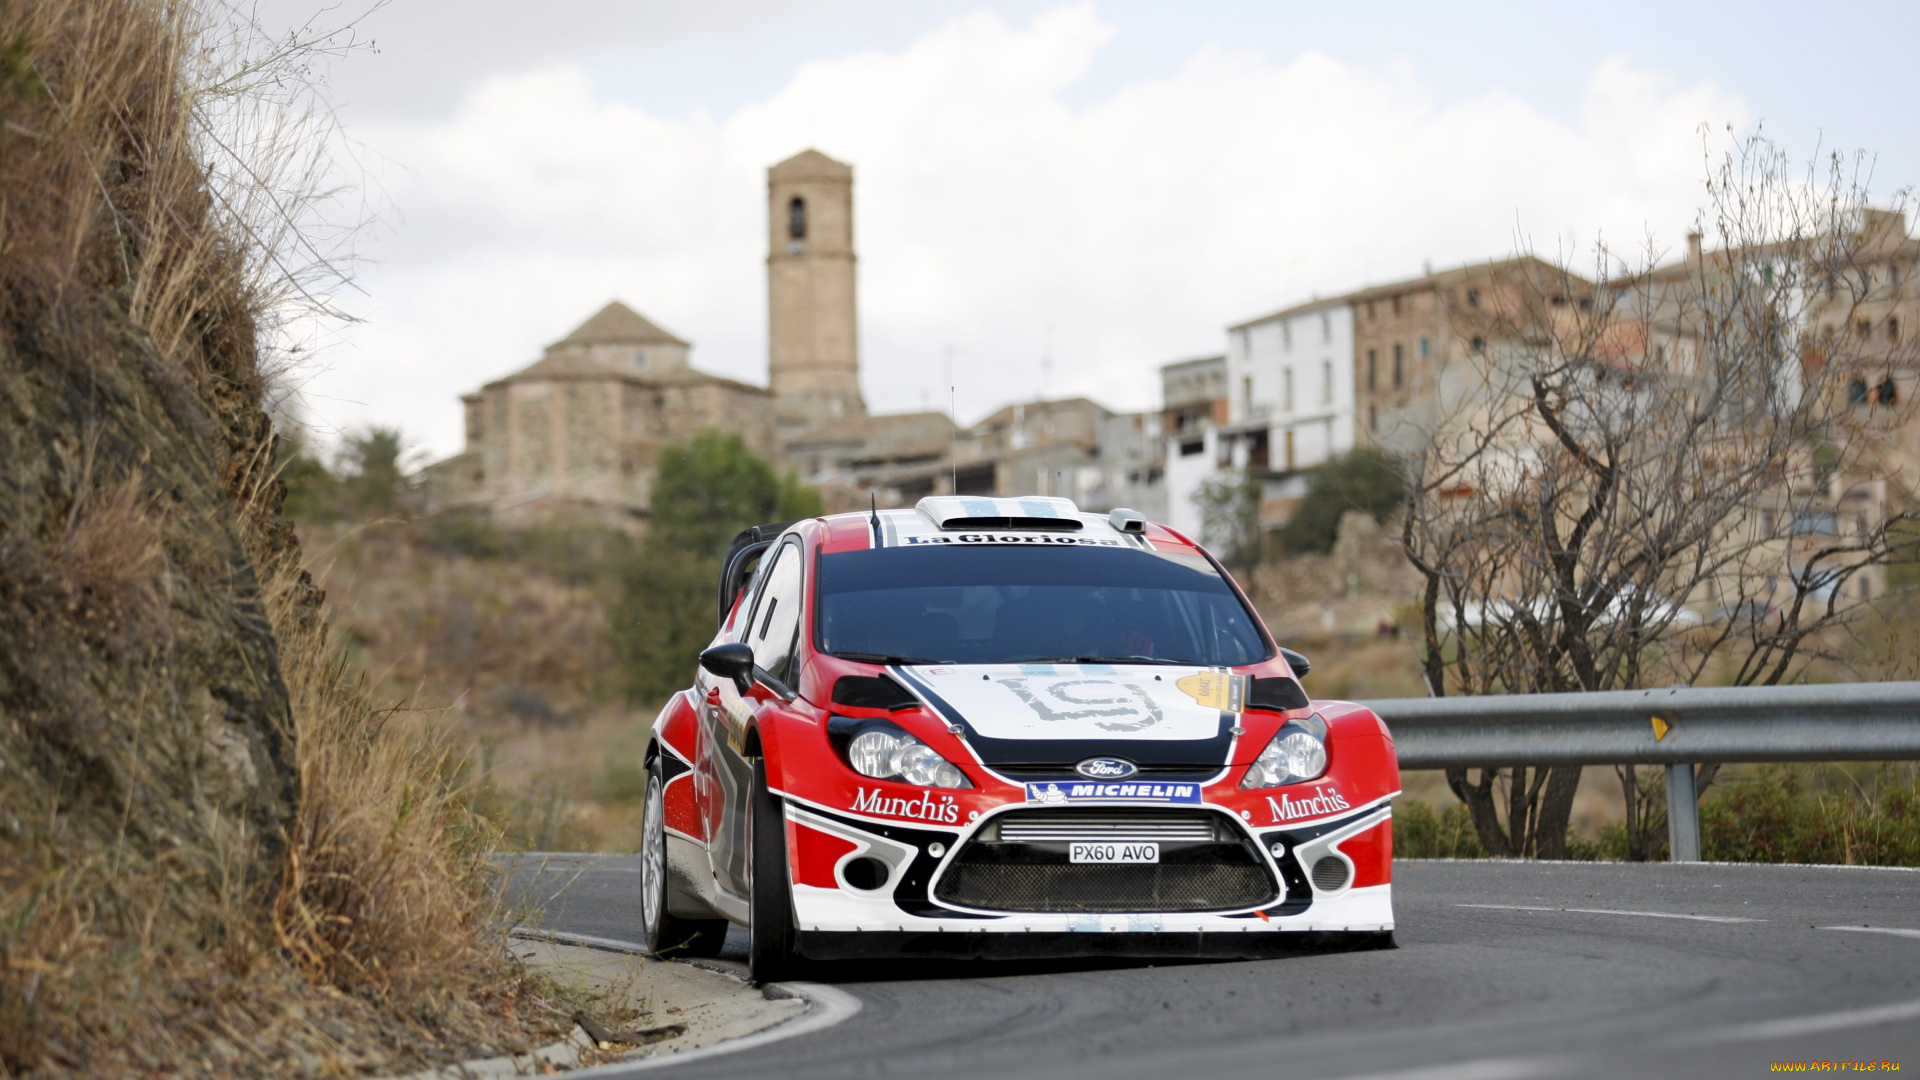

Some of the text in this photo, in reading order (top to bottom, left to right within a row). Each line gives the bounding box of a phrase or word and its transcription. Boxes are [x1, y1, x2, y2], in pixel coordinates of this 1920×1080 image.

[904, 534, 1121, 547] La Gloriosa
[1089, 760, 1123, 775] Ford
[1071, 785, 1193, 797] MICHELIN
[848, 786, 959, 824] Munchi's
[1265, 786, 1351, 823] Munchi's
[1073, 846, 1156, 860] PX60 AVO
